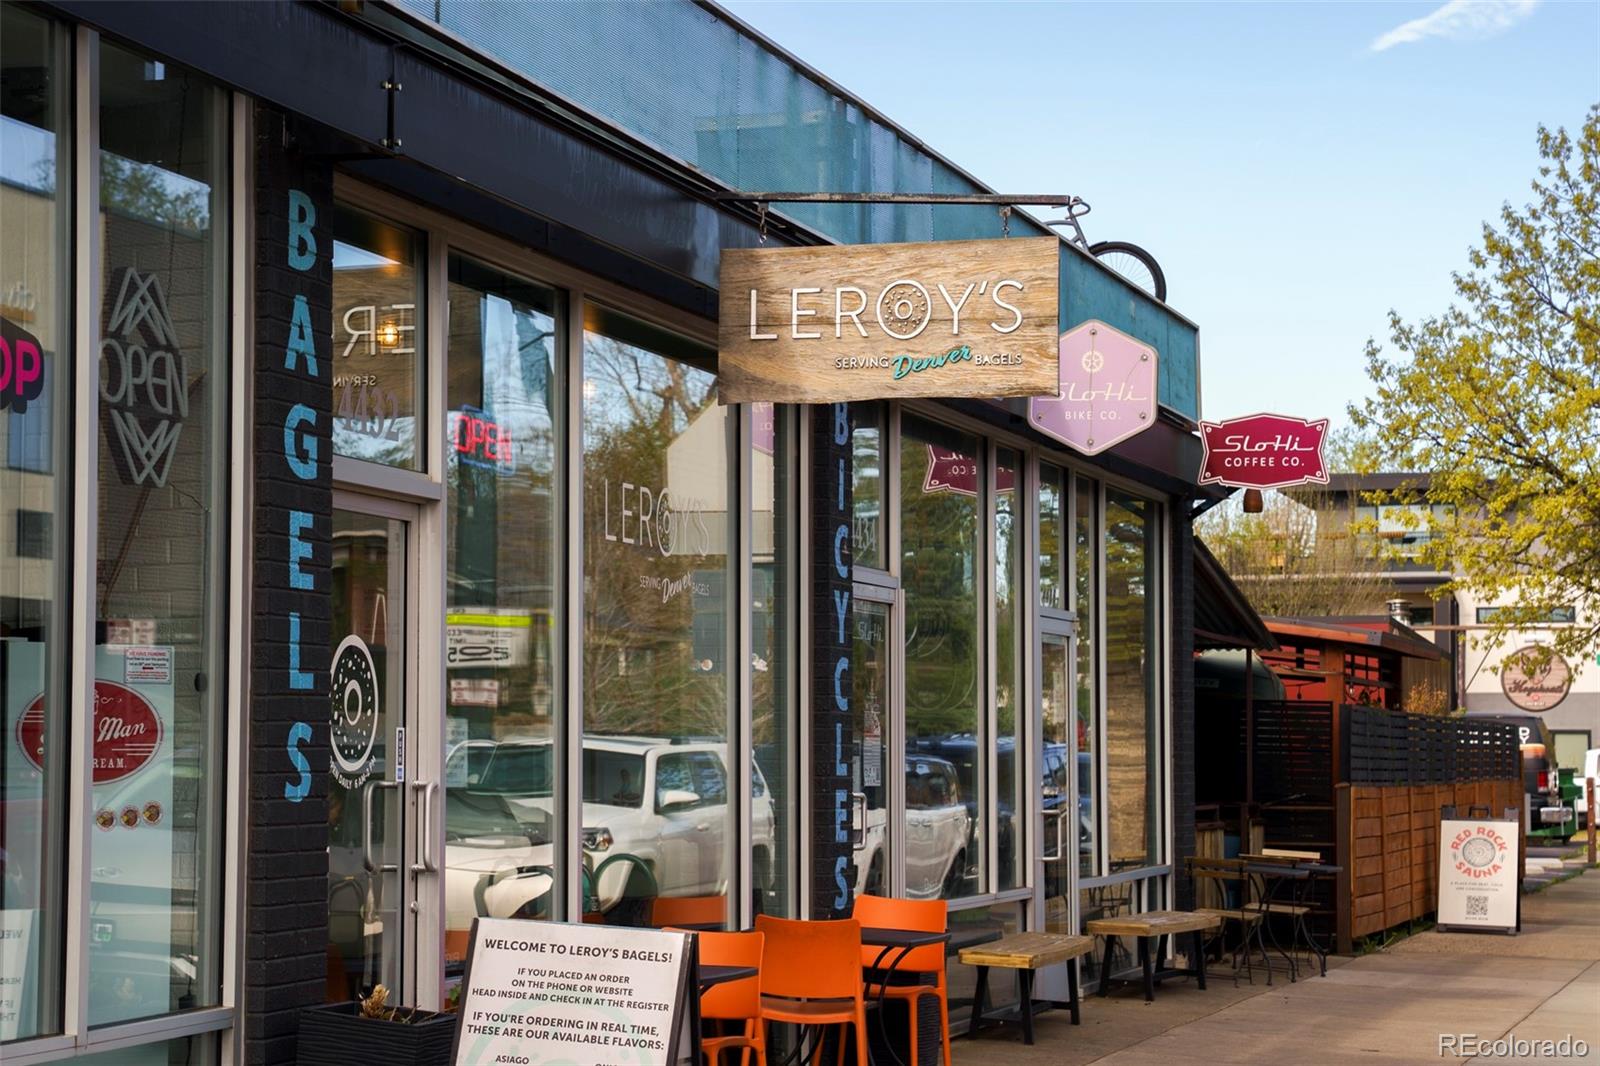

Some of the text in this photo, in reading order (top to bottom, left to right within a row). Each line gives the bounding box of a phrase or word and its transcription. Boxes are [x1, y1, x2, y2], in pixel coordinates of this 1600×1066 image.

[750, 279, 1024, 341] LEROY'S
[835, 344, 1023, 380] SERVING Denver BAGELS
[99, 338, 189, 418] OPEN
[338, 382, 399, 442] 4432
[1064, 410, 1121, 421] BIKE CO.
[454, 414, 512, 464] OPEN
[1213, 434, 1314, 453] SloHi
[1224, 456, 1305, 468] COFFEE CO.
[284, 189, 317, 803] BAGELS
[834, 401, 849, 910] BICYCLES
[97, 716, 146, 743] Man
[1451, 826, 1508, 851] RED ROCK
[1455, 861, 1502, 879] SAUNA
[485, 938, 673, 963] WELCOME TO LEROY'S BAGELS!
[511, 979, 633, 996] ON THE PHONE OR WEBSITE
[517, 967, 630, 984] IF YOU PLACED AN ORDER
[472, 988, 669, 1011] HEAD INSIDE AND CHECK IN AT THE REGISTER
[472, 1011, 659, 1037] IF YOU'RE ORDERING IN REAL TIME,
[467, 1024, 665, 1050] THESE ARE OUR AVAILABLE FLAVORS:
[495, 1055, 530, 1065] ASIAGO
